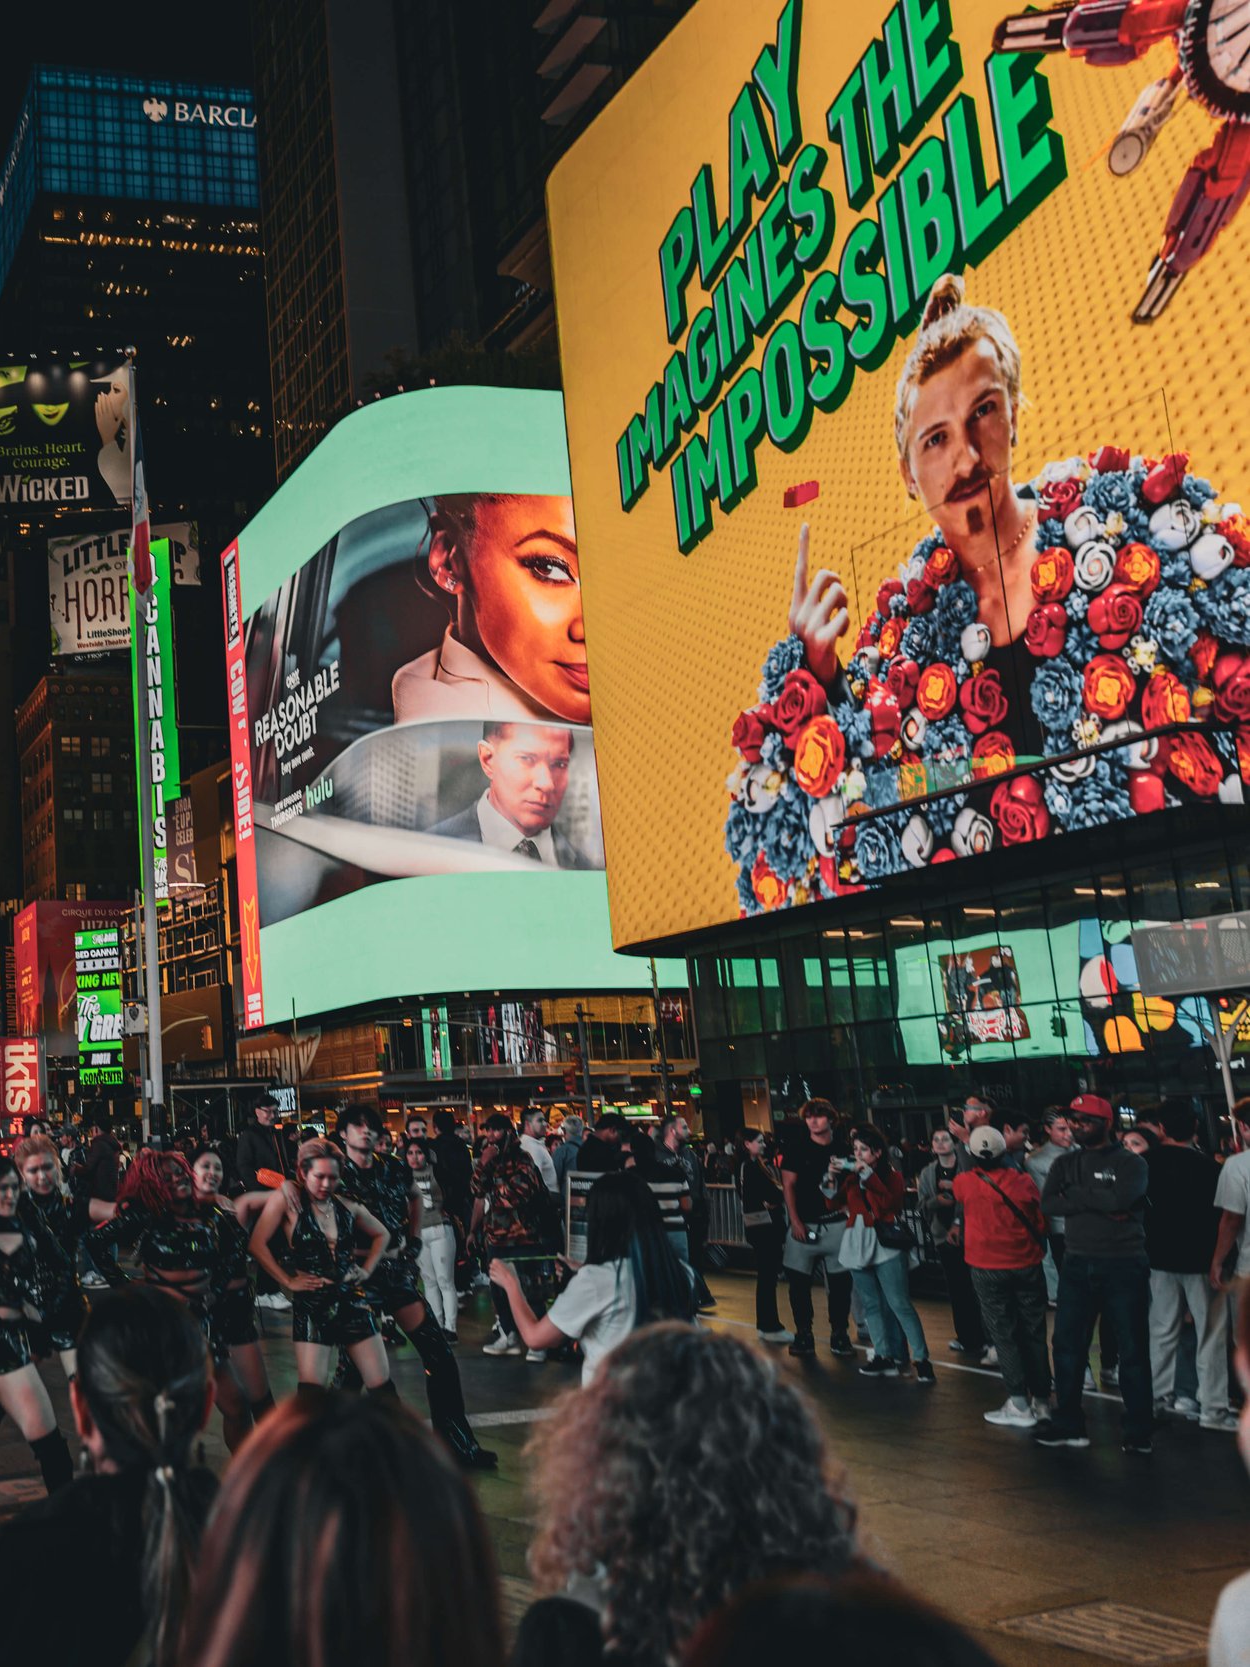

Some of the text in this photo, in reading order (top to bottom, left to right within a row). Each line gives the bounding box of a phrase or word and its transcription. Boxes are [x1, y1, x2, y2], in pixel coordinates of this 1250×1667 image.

[659, 0, 803, 343] PLAY
[616, 0, 963, 513] IMAGINES THE
[669, 35, 1068, 555] IMPOSSIBLE
[13, 456, 70, 470] Courage.
[45, 442, 86, 455] Heart.
[63, 533, 130, 577] LITTLE
[145, 594, 167, 849] CANNABIS
[254, 659, 340, 747] REASONABLE
[274, 705, 318, 759] DOUBT
[305, 776, 333, 810] hulu
[4, 1041, 38, 1113] tkts
